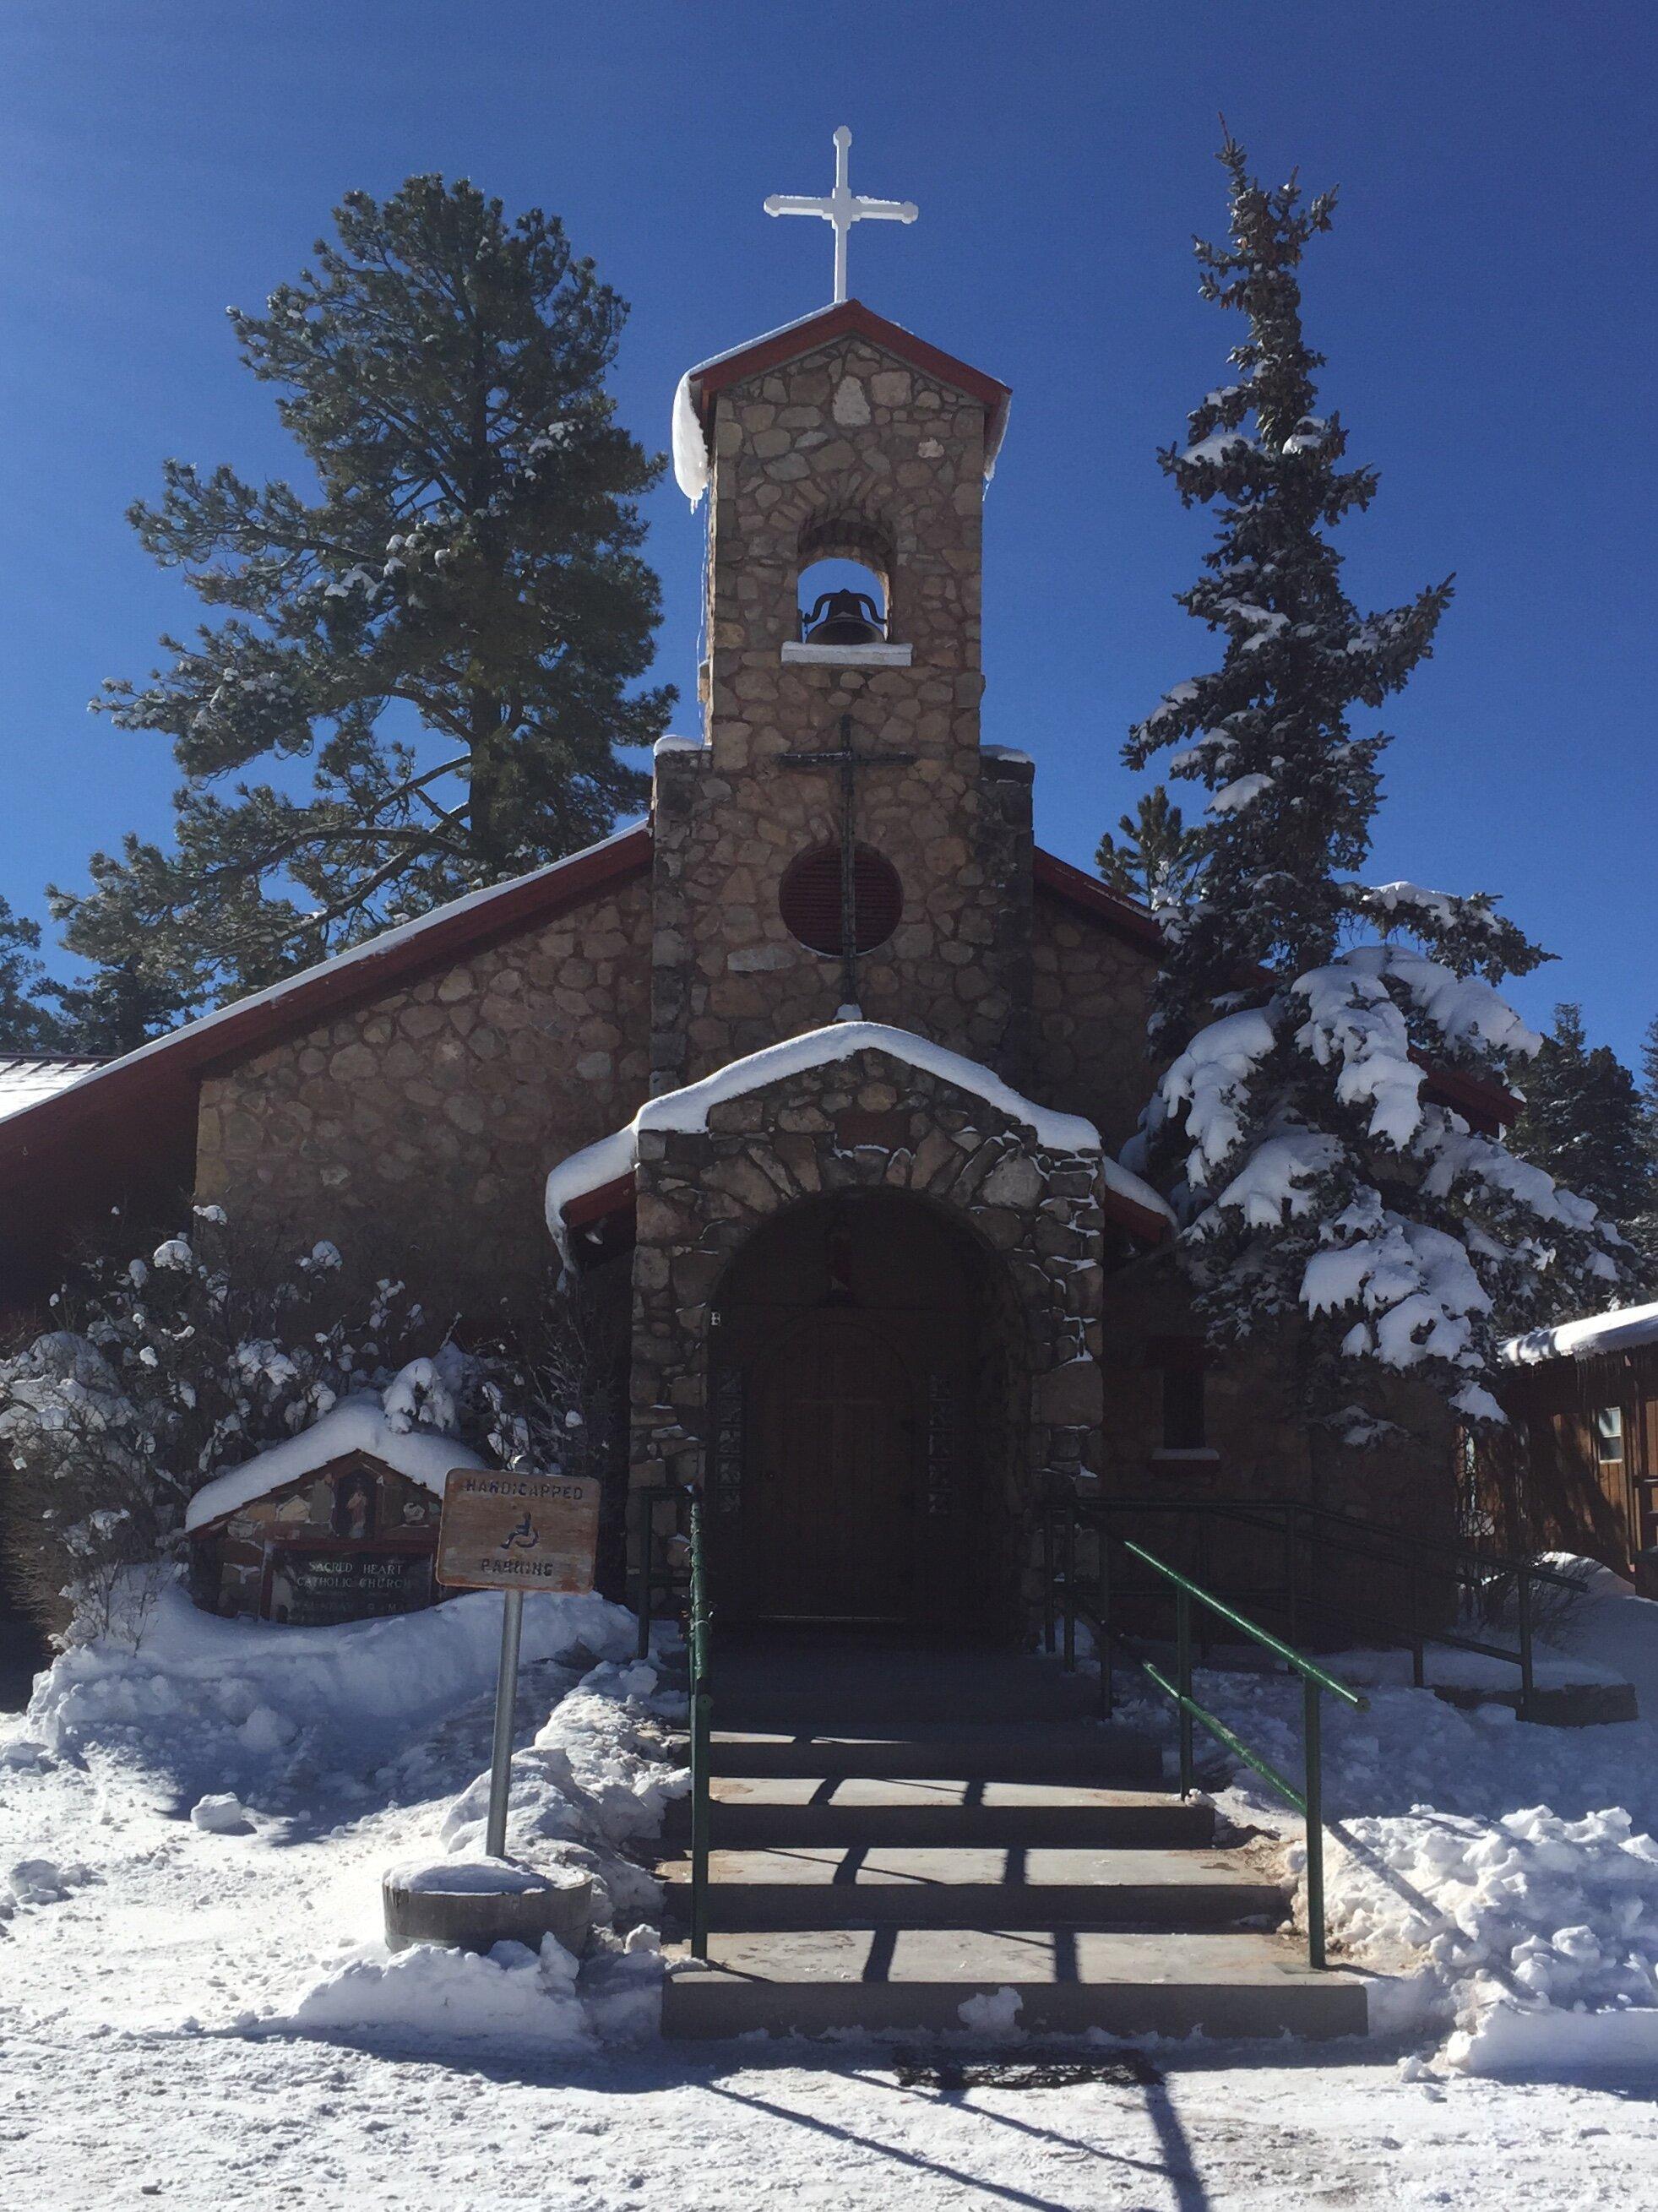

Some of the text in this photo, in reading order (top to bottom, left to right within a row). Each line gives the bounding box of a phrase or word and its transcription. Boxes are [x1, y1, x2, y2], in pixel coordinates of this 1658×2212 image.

[465, 1478, 584, 1500] HANDICAPPED
[308, 1562, 403, 1575] SACRED HEART
[481, 1558, 554, 1577] PARKING
[296, 1576, 411, 1589] CATHOLIC CHURCH
